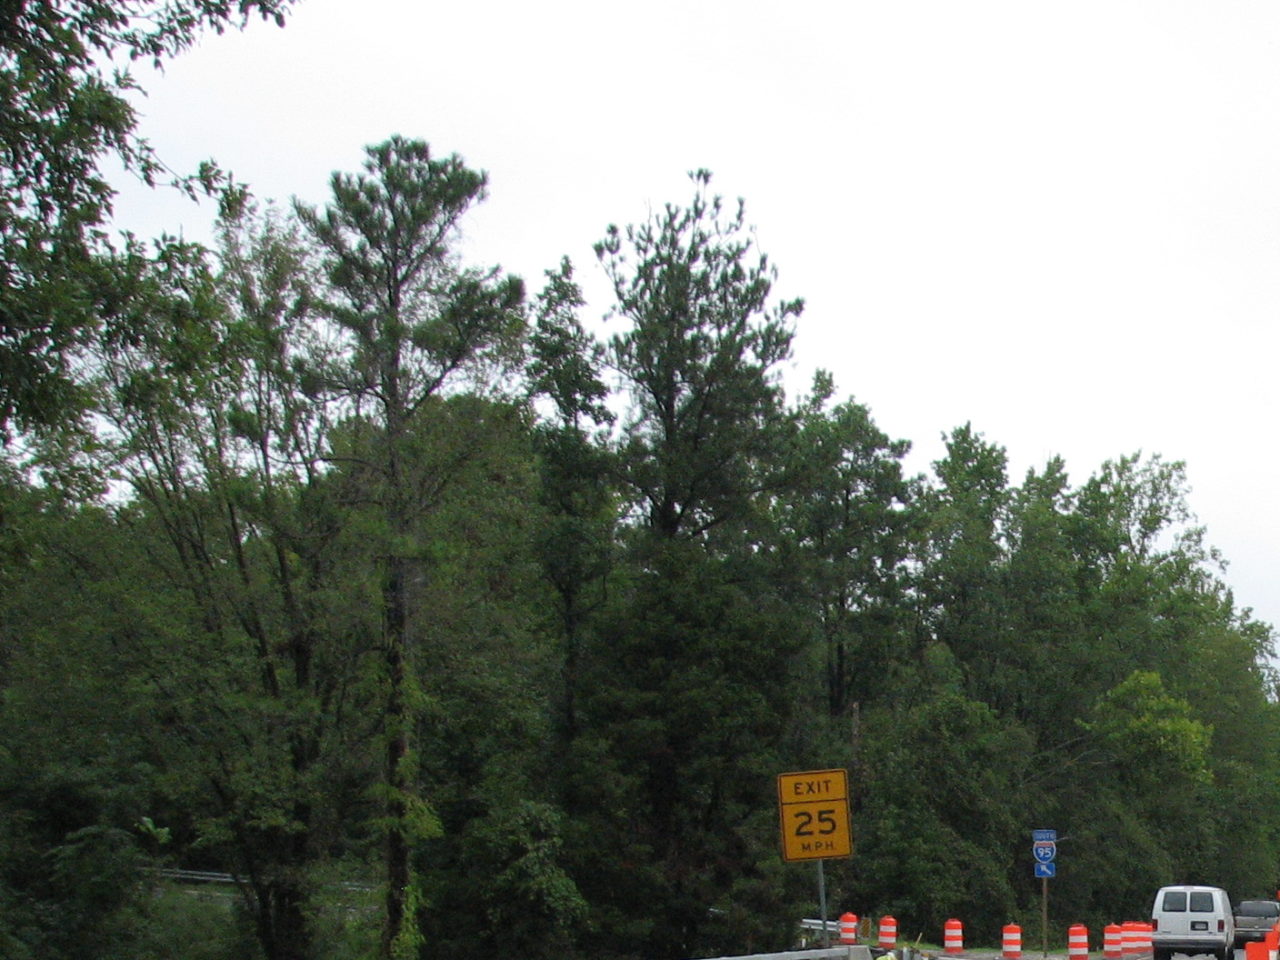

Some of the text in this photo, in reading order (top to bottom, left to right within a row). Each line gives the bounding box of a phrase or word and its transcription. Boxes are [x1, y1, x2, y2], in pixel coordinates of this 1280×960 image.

[794, 780, 831, 795] EXIT
[794, 810, 836, 836] 25
[802, 840, 834, 852] MPH
[1038, 848, 1051, 857] 95
